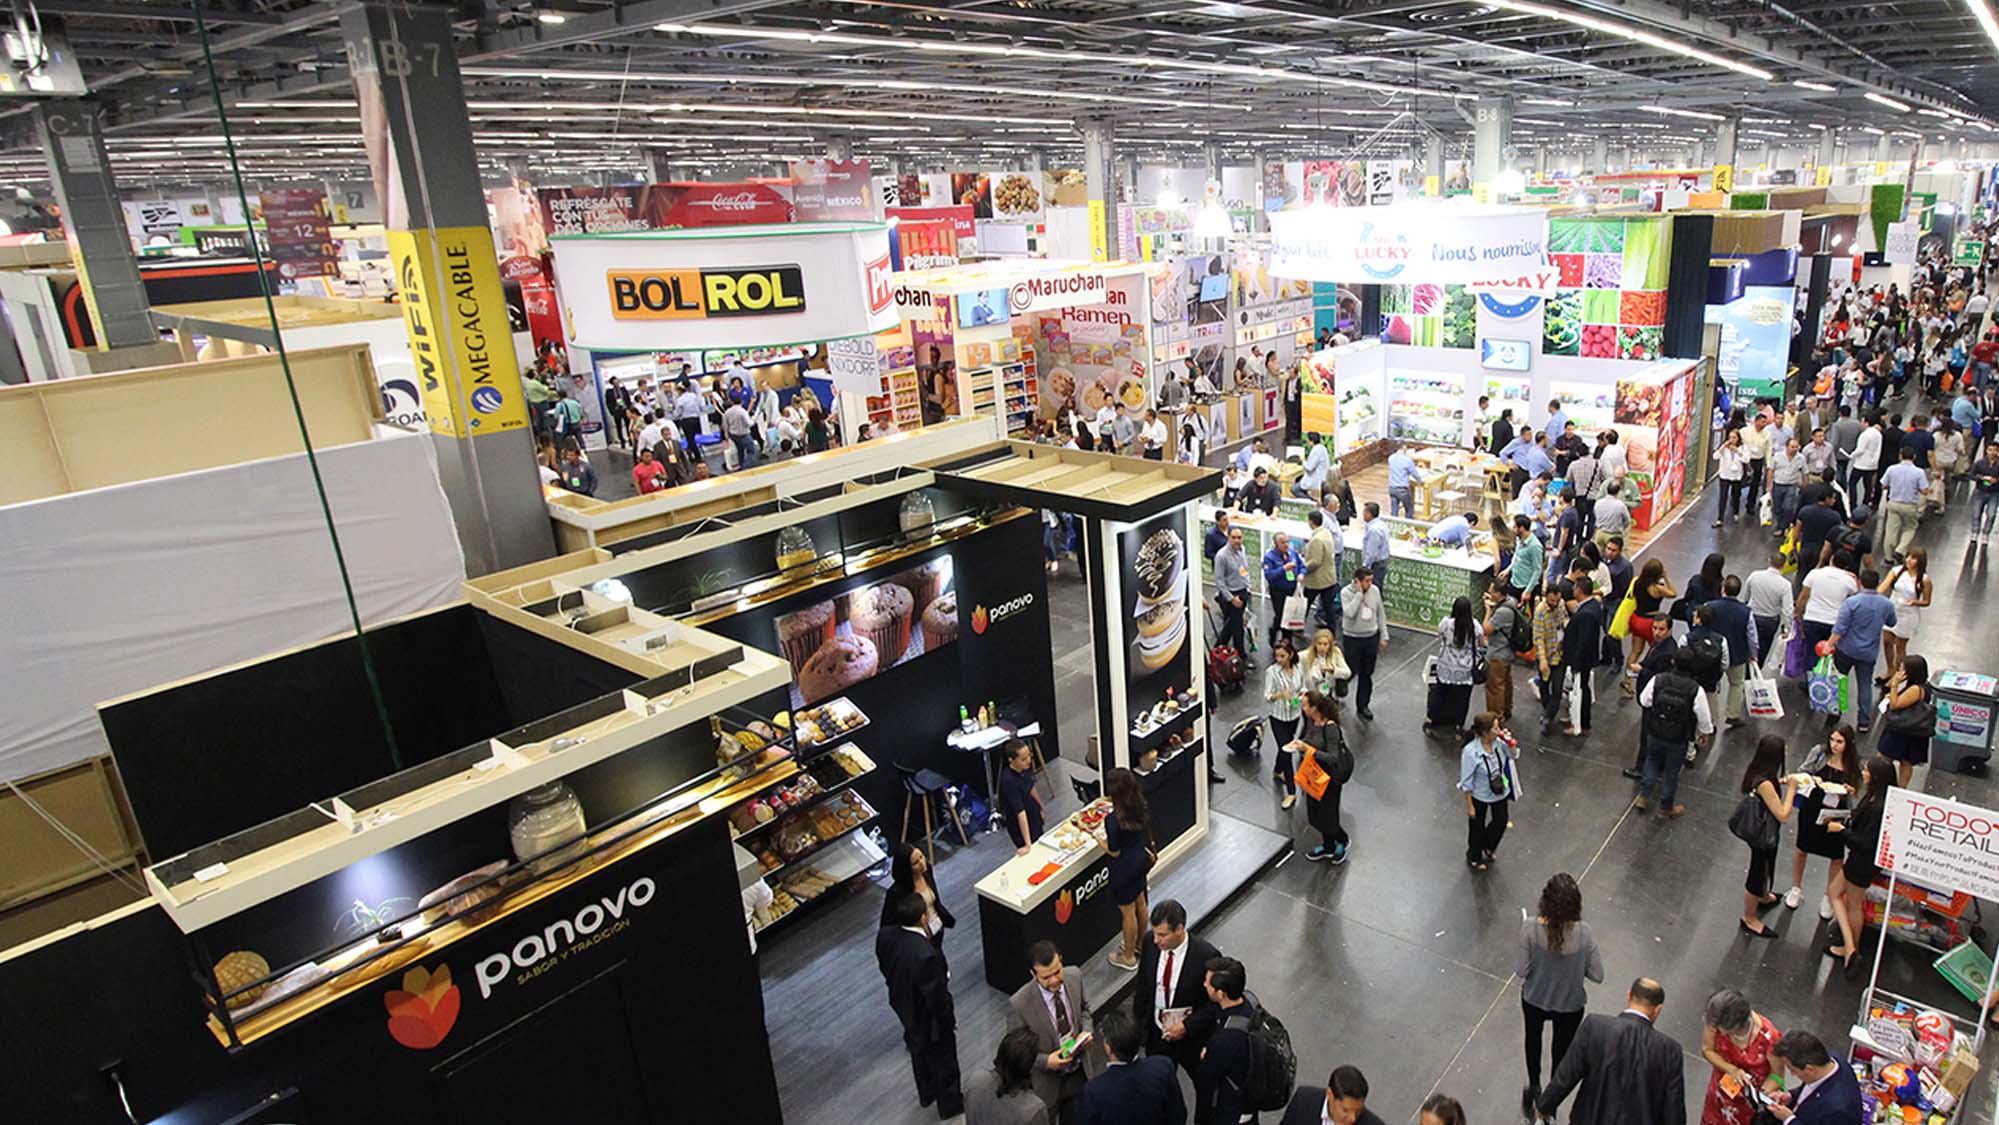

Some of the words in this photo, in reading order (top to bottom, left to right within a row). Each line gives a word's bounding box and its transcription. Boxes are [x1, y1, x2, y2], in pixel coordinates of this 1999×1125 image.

[1354, 247, 1412, 259] LUCKY
[1432, 243, 1477, 262] Nous
[1028, 273, 1105, 297] Maruchan
[445, 246, 493, 384] MEGACABLE
[1061, 306, 1132, 325] Ramen
[990, 593, 1034, 623] panovo
[1907, 799, 1992, 836] TODO
[1909, 818, 1999, 856] RETAIL
[474, 877, 656, 1000] panovo
[516, 956, 559, 985] SABOR
